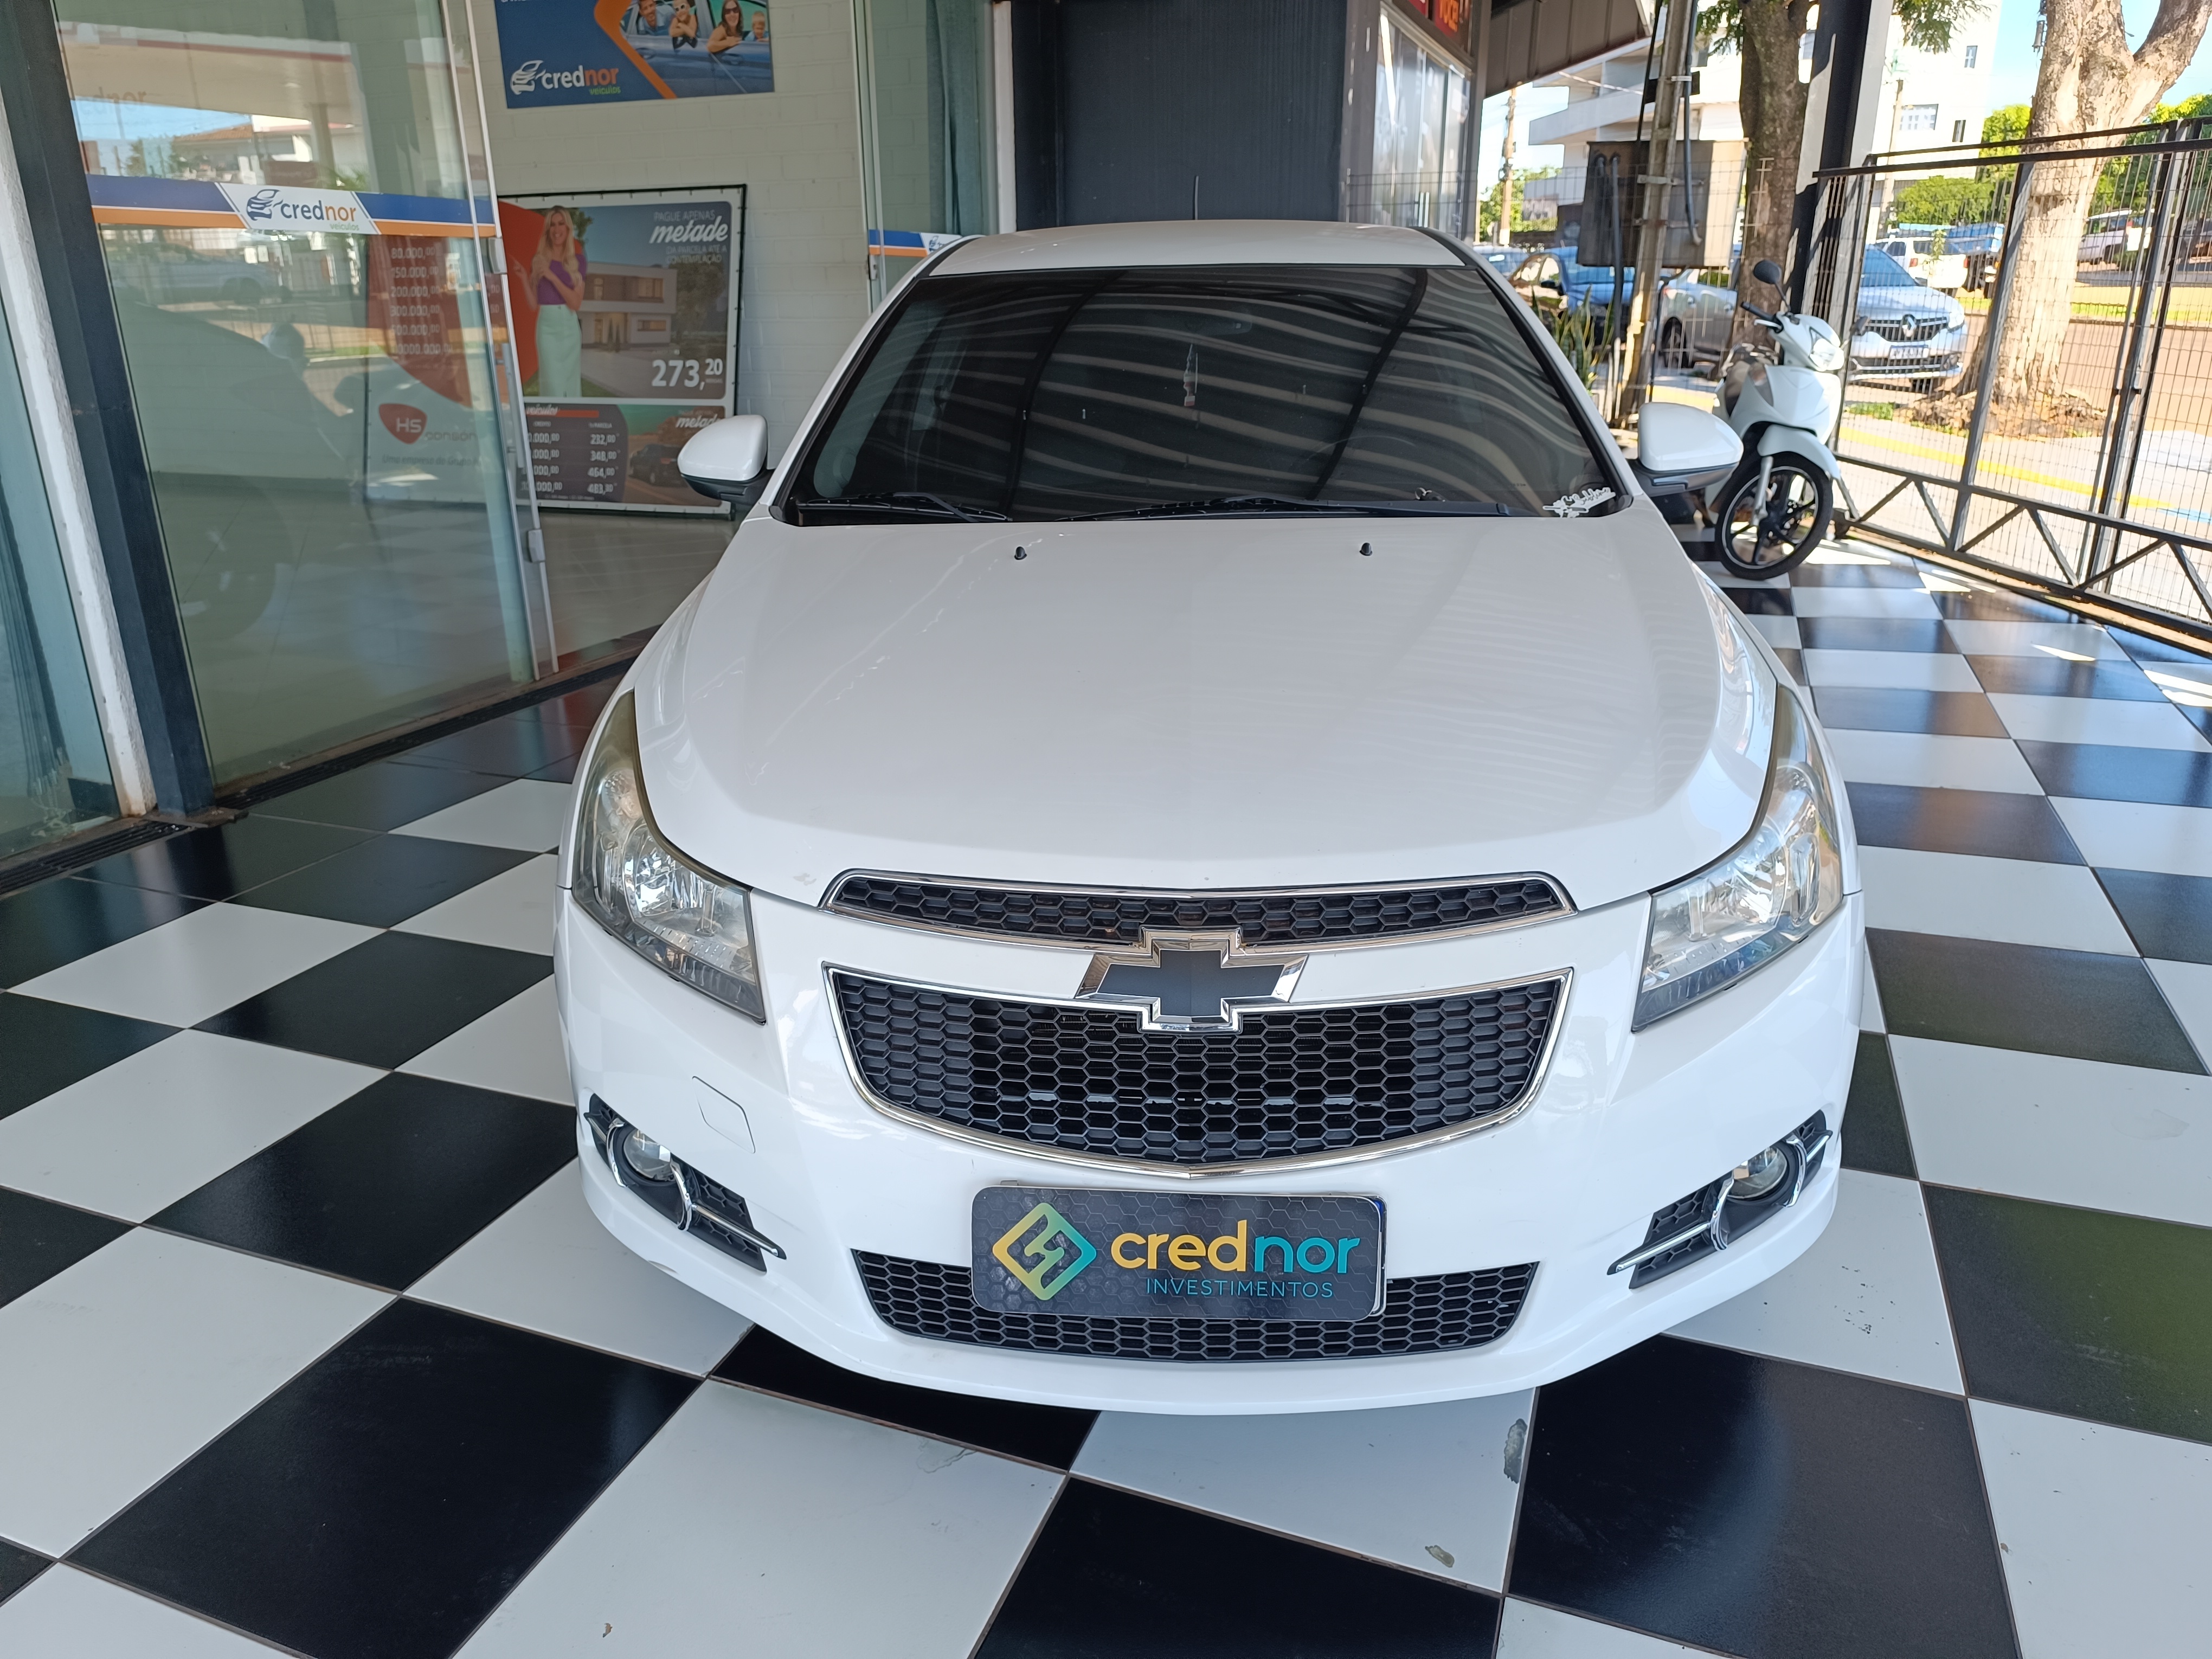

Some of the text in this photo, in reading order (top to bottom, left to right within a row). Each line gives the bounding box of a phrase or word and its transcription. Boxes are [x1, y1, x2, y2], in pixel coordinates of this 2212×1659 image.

[542, 65, 619, 89] crednor
[280, 200, 356, 221] crednor
[649, 216, 728, 243] metade
[652, 358, 723, 390] 273,20
[396, 417, 422, 433] HS
[676, 414, 719, 428] metad
[1111, 1219, 1360, 1274] crednor
[1146, 1278, 1333, 1298] INVESTIMENTOS
